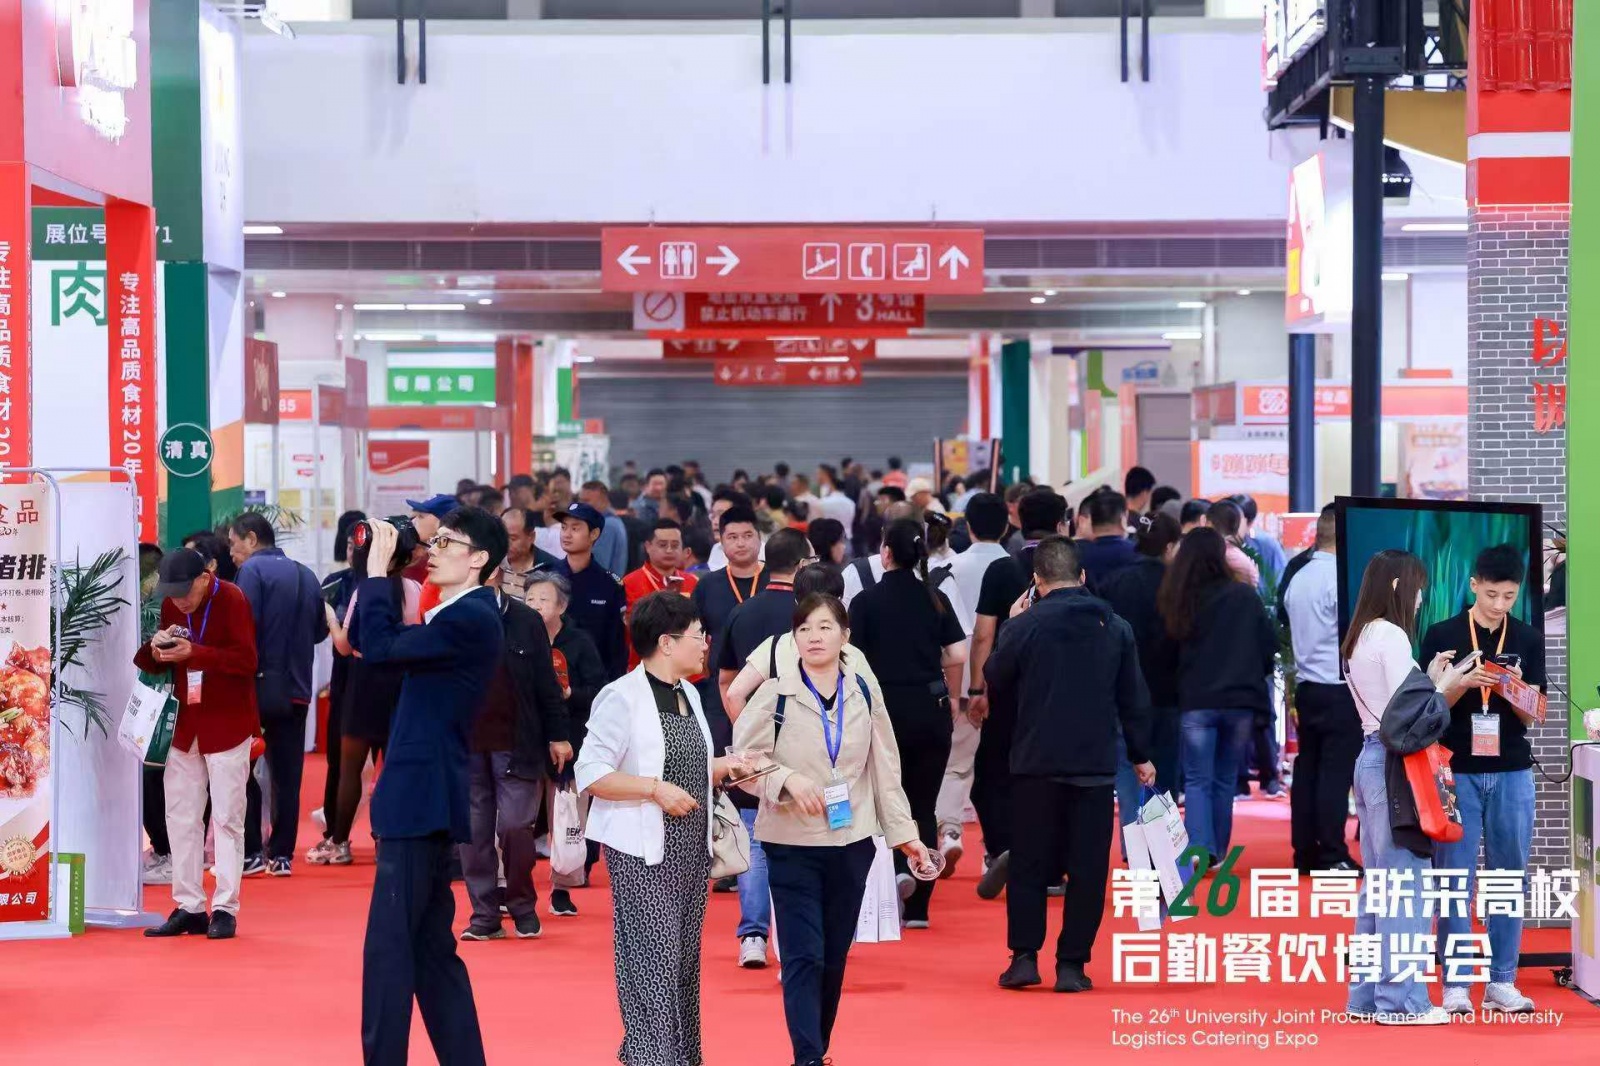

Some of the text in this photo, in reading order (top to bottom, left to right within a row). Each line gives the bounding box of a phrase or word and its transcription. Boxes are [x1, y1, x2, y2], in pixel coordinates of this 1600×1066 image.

[45, 223, 106, 244] 展位号
[51, 260, 108, 326] 肉
[877, 311, 915, 321] HALL
[120, 271, 143, 477] 专注高品质食材20年
[165, 440, 208, 459] 清真
